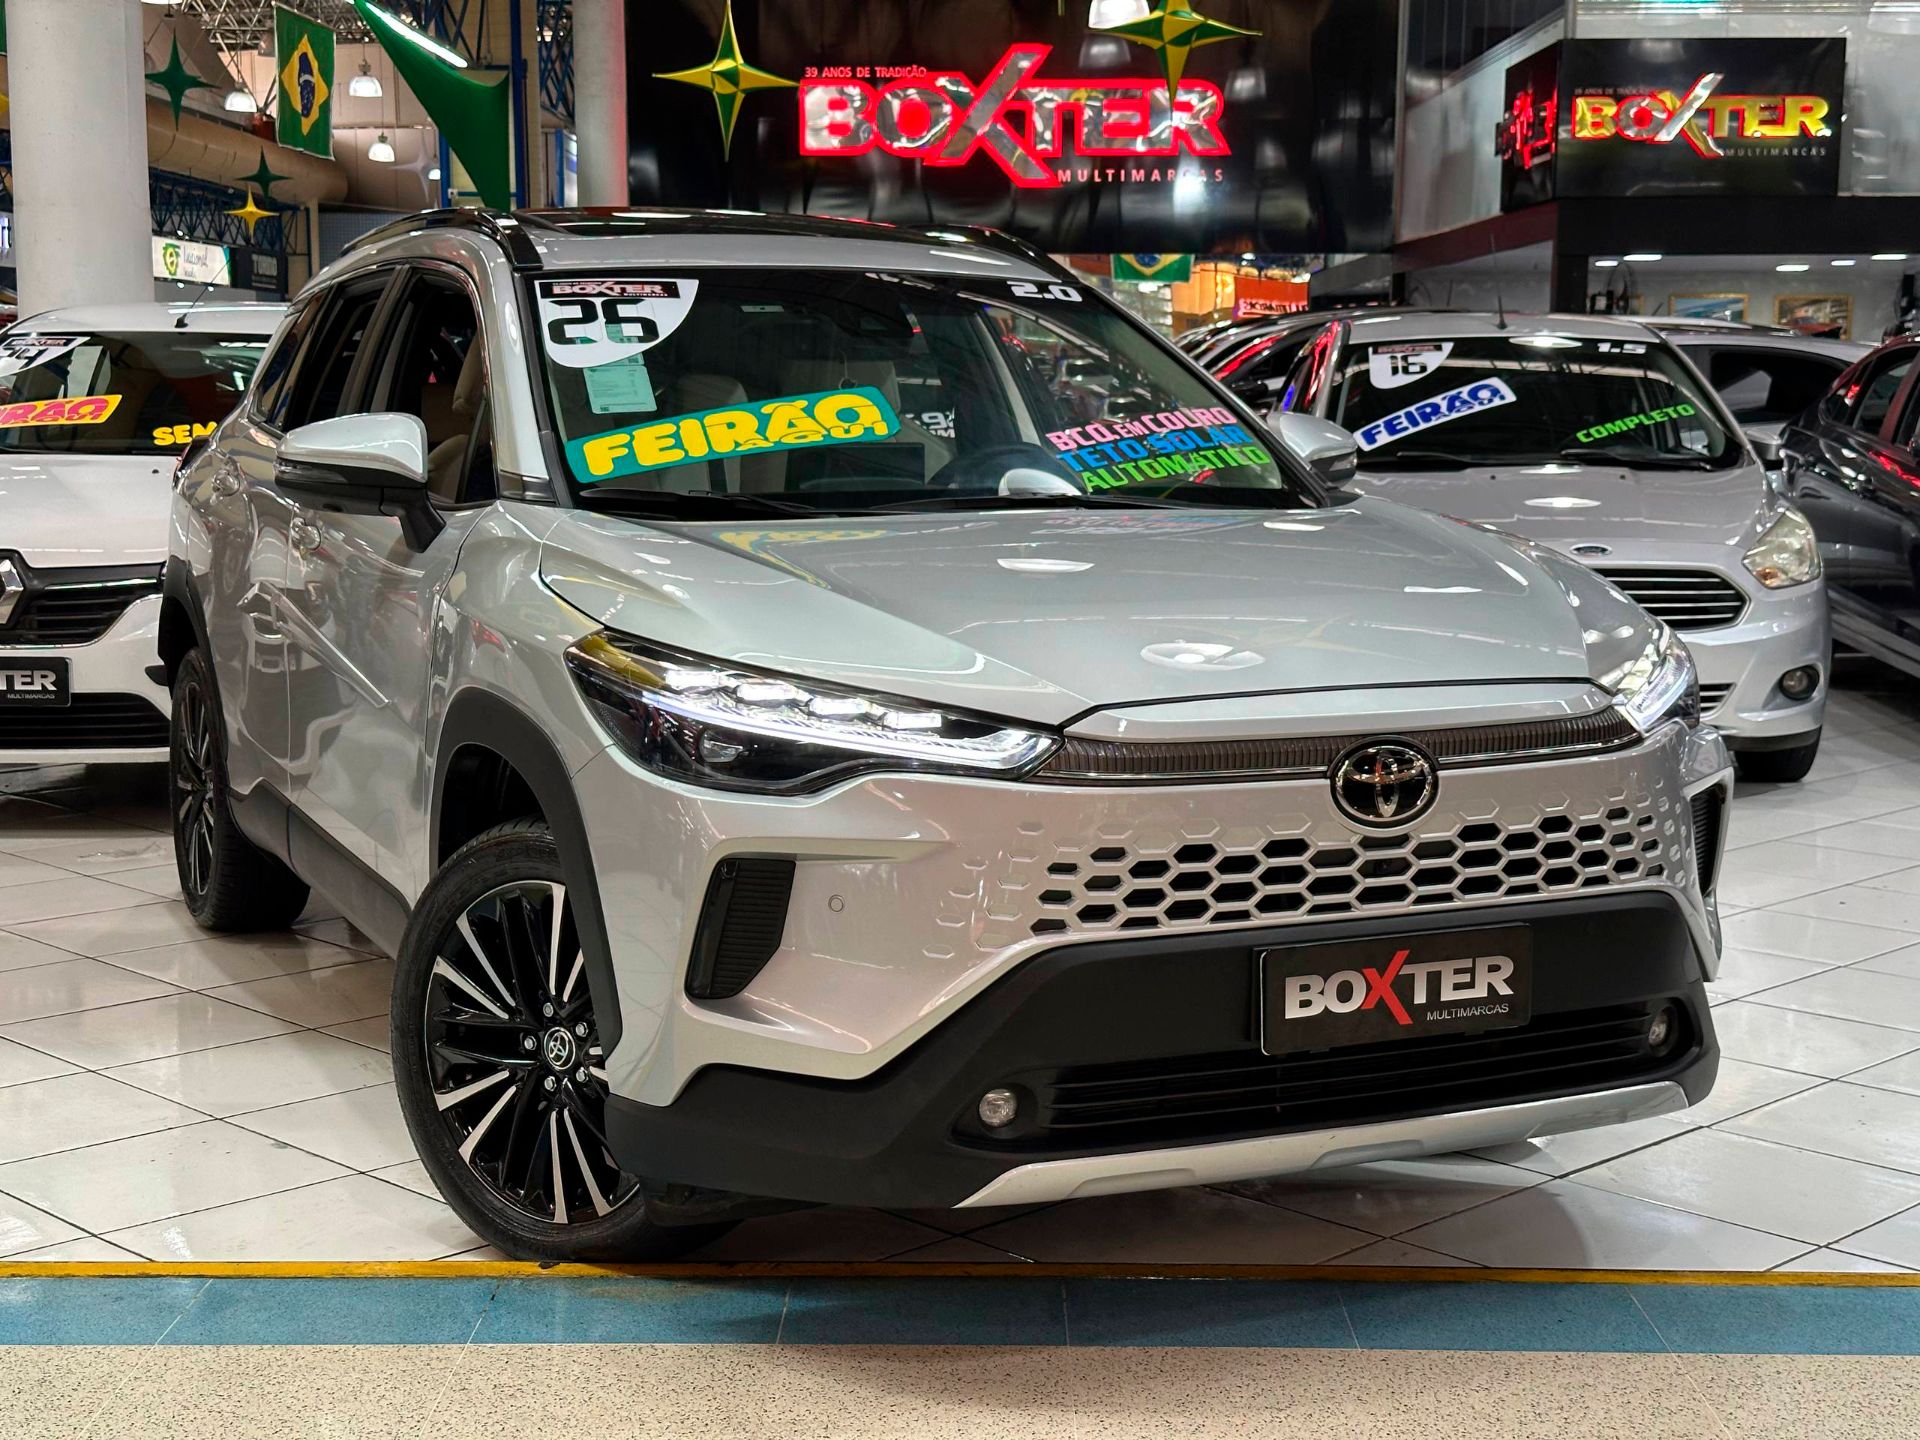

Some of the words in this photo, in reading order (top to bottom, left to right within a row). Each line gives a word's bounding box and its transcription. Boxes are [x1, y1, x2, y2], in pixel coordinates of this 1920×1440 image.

[805, 66, 818, 78] 39
[822, 66, 852, 78] ANOS
[856, 66, 871, 78] DE
[875, 64, 927, 78] TRADIÇÃO
[799, 43, 1232, 188] BOXTER
[1571, 72, 1832, 158] BOXTER
[1725, 146, 1827, 157] MULTIMARCAS
[552, 281, 664, 296] BOXTER
[1006, 280, 1083, 302] 2.0
[547, 298, 660, 345] 26
[1388, 354, 1428, 377] 16
[1597, 342, 1647, 354] 1.5
[1113, 420, 1148, 438] EM
[1141, 407, 1238, 434] COURO
[1361, 383, 1501, 446] FEIRÃO
[1576, 403, 1696, 443] COMPLETO
[582, 392, 883, 476] FEIRÃO
[1056, 438, 1148, 472] TETO
[1147, 424, 1254, 455] SOLAR
[1284, 950, 1515, 1025] BOXTER
[1426, 1003, 1509, 1021] MULTIMARCAS
